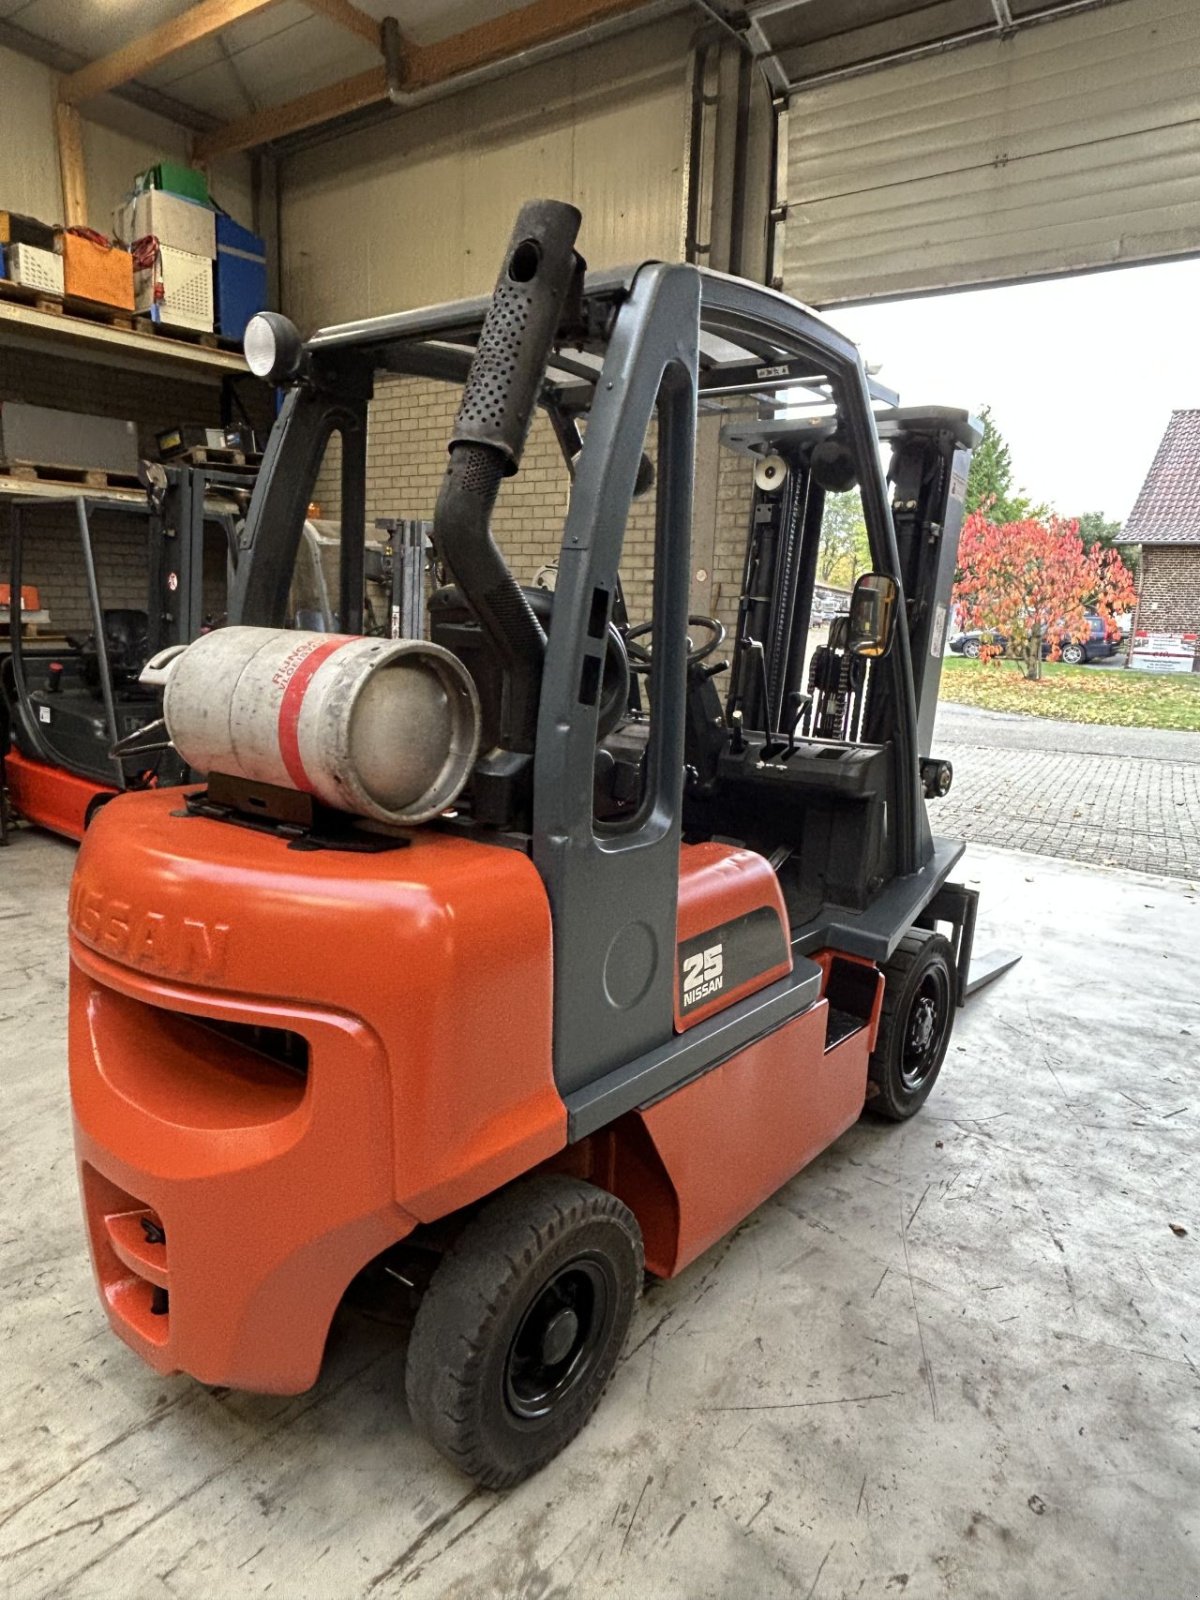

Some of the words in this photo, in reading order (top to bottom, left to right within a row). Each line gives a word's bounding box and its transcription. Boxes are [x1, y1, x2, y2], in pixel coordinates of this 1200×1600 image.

[72, 883, 230, 980] ISSAN
[683, 943, 723, 992] 25
[683, 976, 723, 1007] NISSAN
